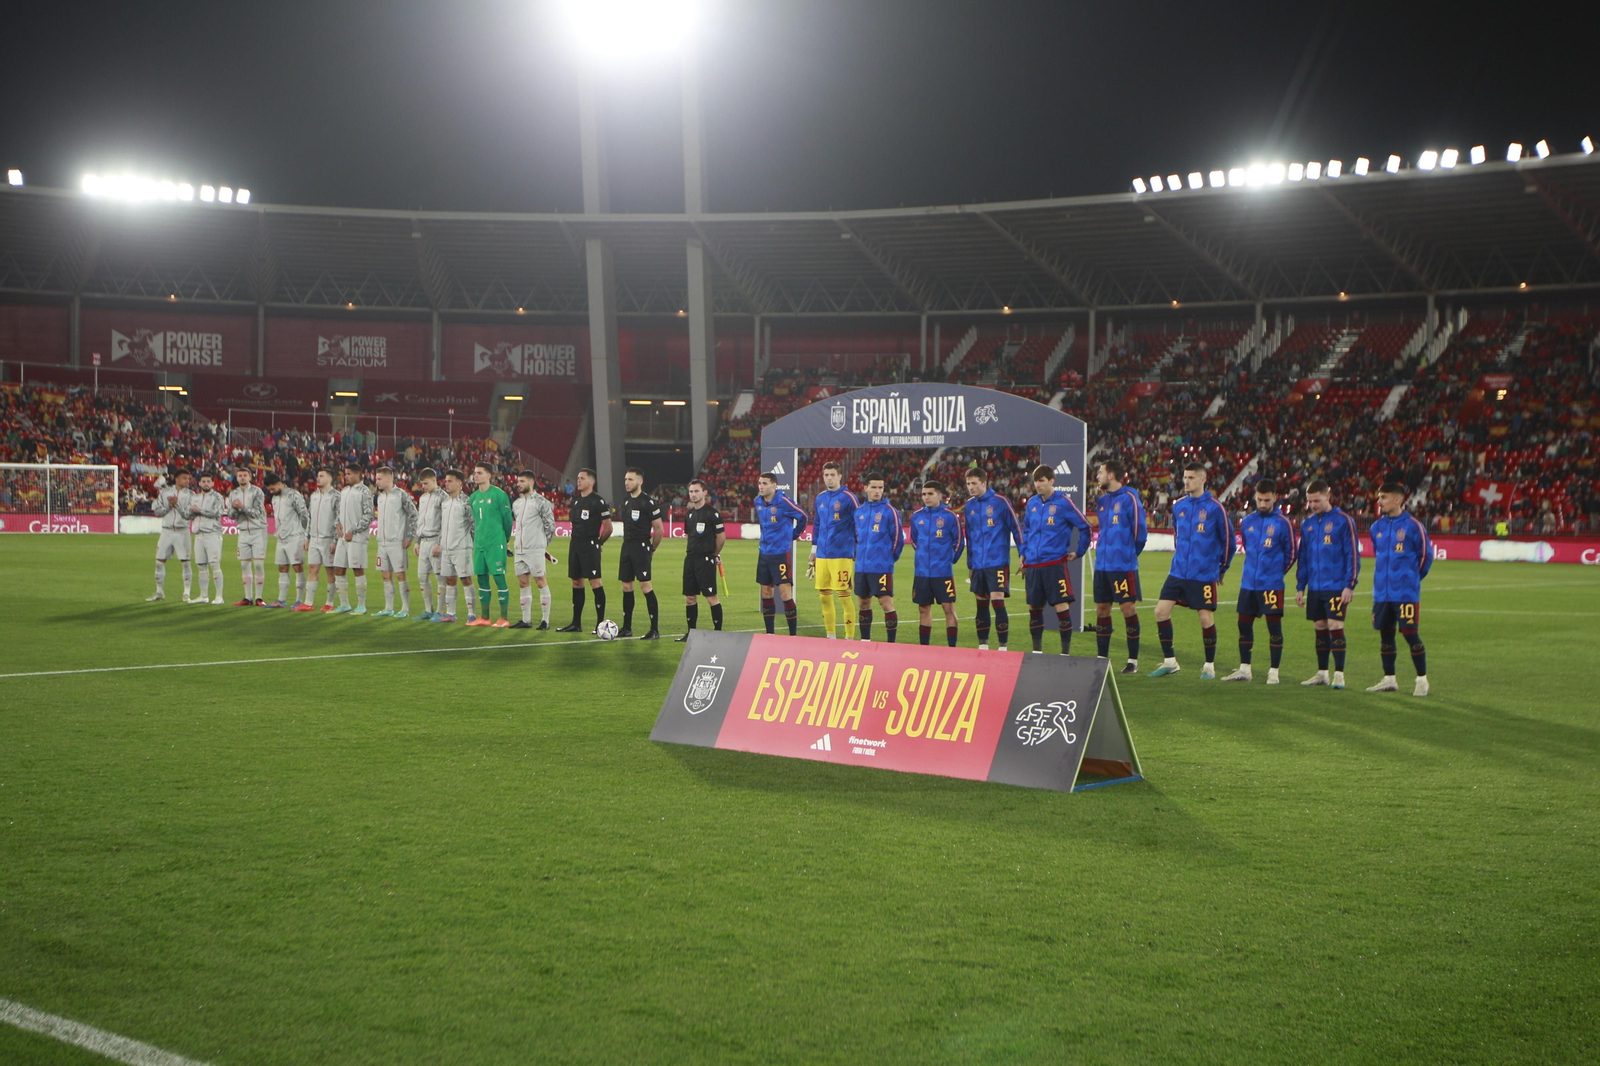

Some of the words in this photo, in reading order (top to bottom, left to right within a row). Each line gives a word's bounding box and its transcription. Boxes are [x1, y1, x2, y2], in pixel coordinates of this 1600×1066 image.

[166, 331, 222, 349] POWER
[351, 335, 387, 349] POWER
[166, 348, 222, 366] HORSE
[351, 346, 386, 358] HORSE
[524, 344, 575, 360] POWER
[316, 356, 387, 367] STADIUM
[524, 359, 576, 376] HORSE
[404, 393, 479, 404] CaixaBank
[852, 392, 911, 434] ESPAÑA
[922, 396, 966, 433] SUIZA
[29, 520, 89, 534] Cazorla
[779, 563, 787, 576] 9
[837, 571, 849, 582] 13
[997, 570, 1004, 583] 5
[879, 574, 887, 586] 4
[945, 580, 953, 592] 2
[1058, 579, 1066, 593] 3
[1114, 579, 1128, 594] 14
[1203, 585, 1212, 599] 8
[1263, 590, 1278, 605] 16
[1329, 596, 1342, 611] 17
[1399, 603, 1414, 619] 10
[747, 651, 874, 731] ESPAÑA
[885, 668, 986, 743] SUIZA
[848, 736, 887, 748] finetwork
